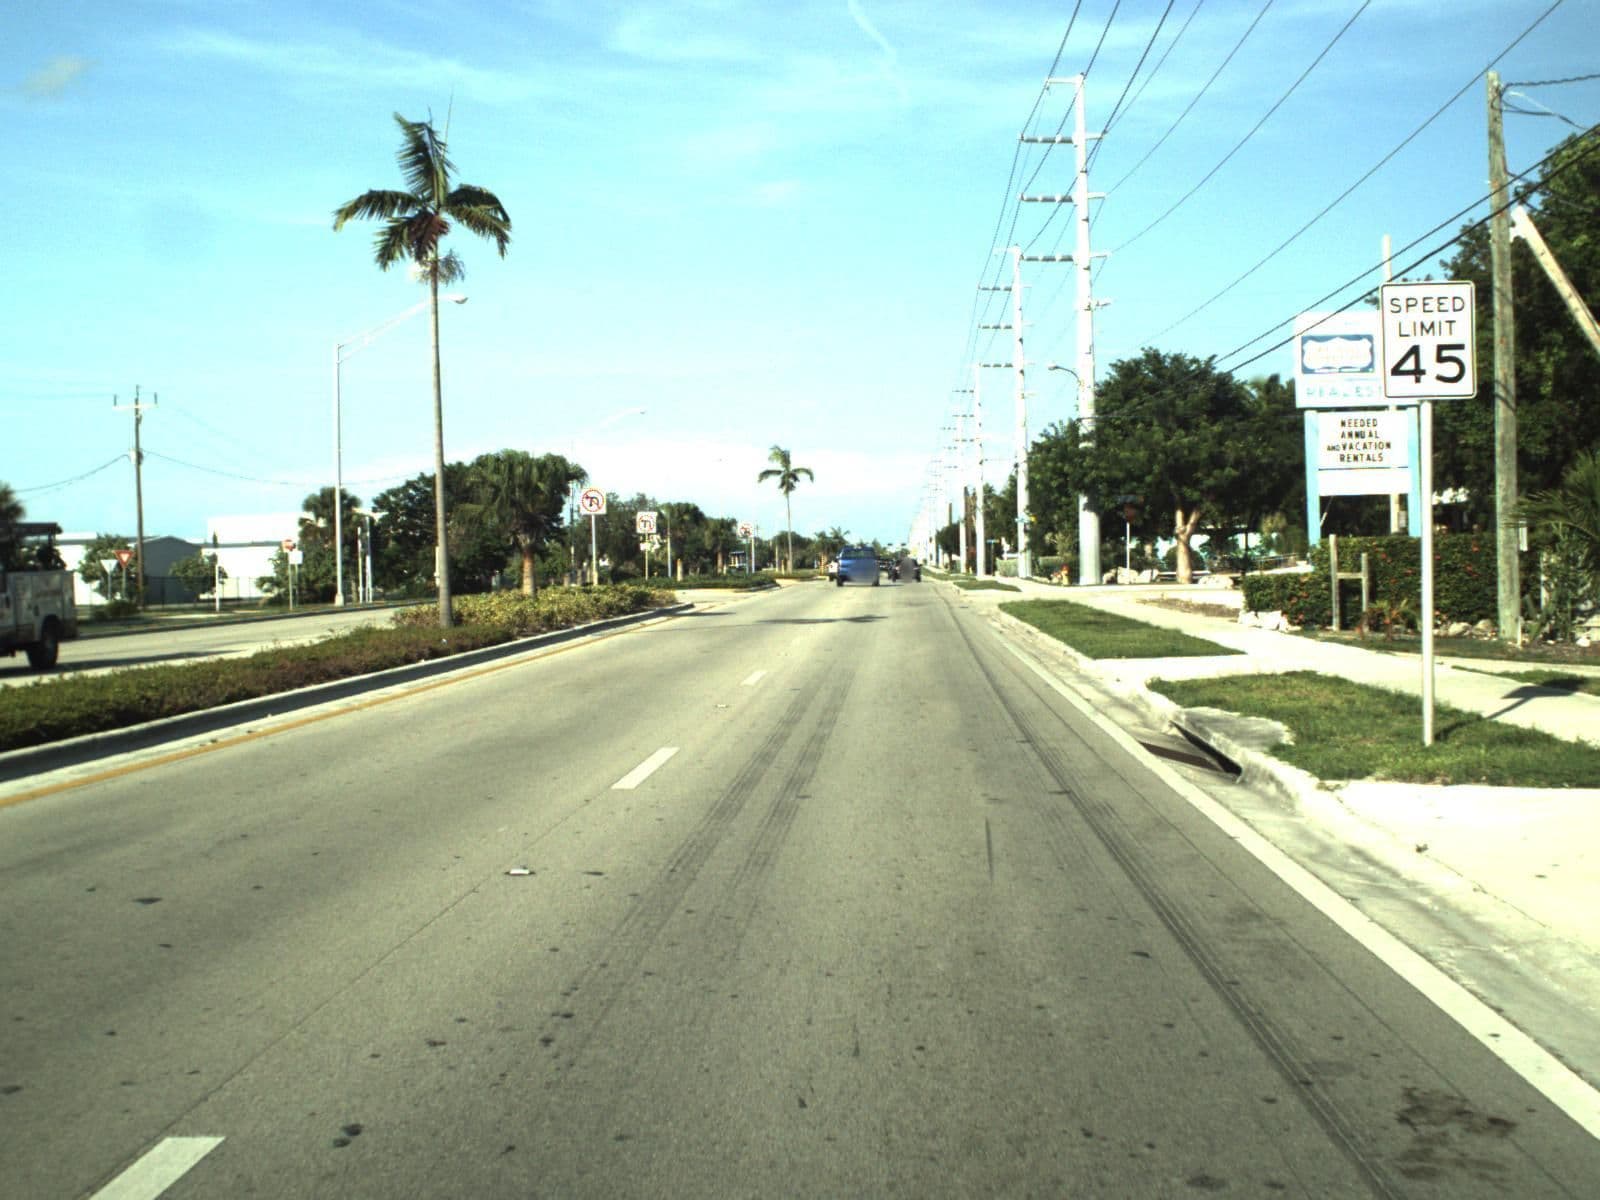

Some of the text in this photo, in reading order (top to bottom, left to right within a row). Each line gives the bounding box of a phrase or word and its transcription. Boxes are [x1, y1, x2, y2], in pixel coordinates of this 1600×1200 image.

[1390, 296, 1465, 313] SPEED
[1398, 320, 1456, 337] LIMIT
[1390, 343, 1466, 384] 45
[1341, 418, 1378, 427] NEEDED
[1341, 430, 1380, 439] ANNUAL
[1341, 441, 1391, 451] VACATION
[1339, 453, 1384, 462] RENTALS
